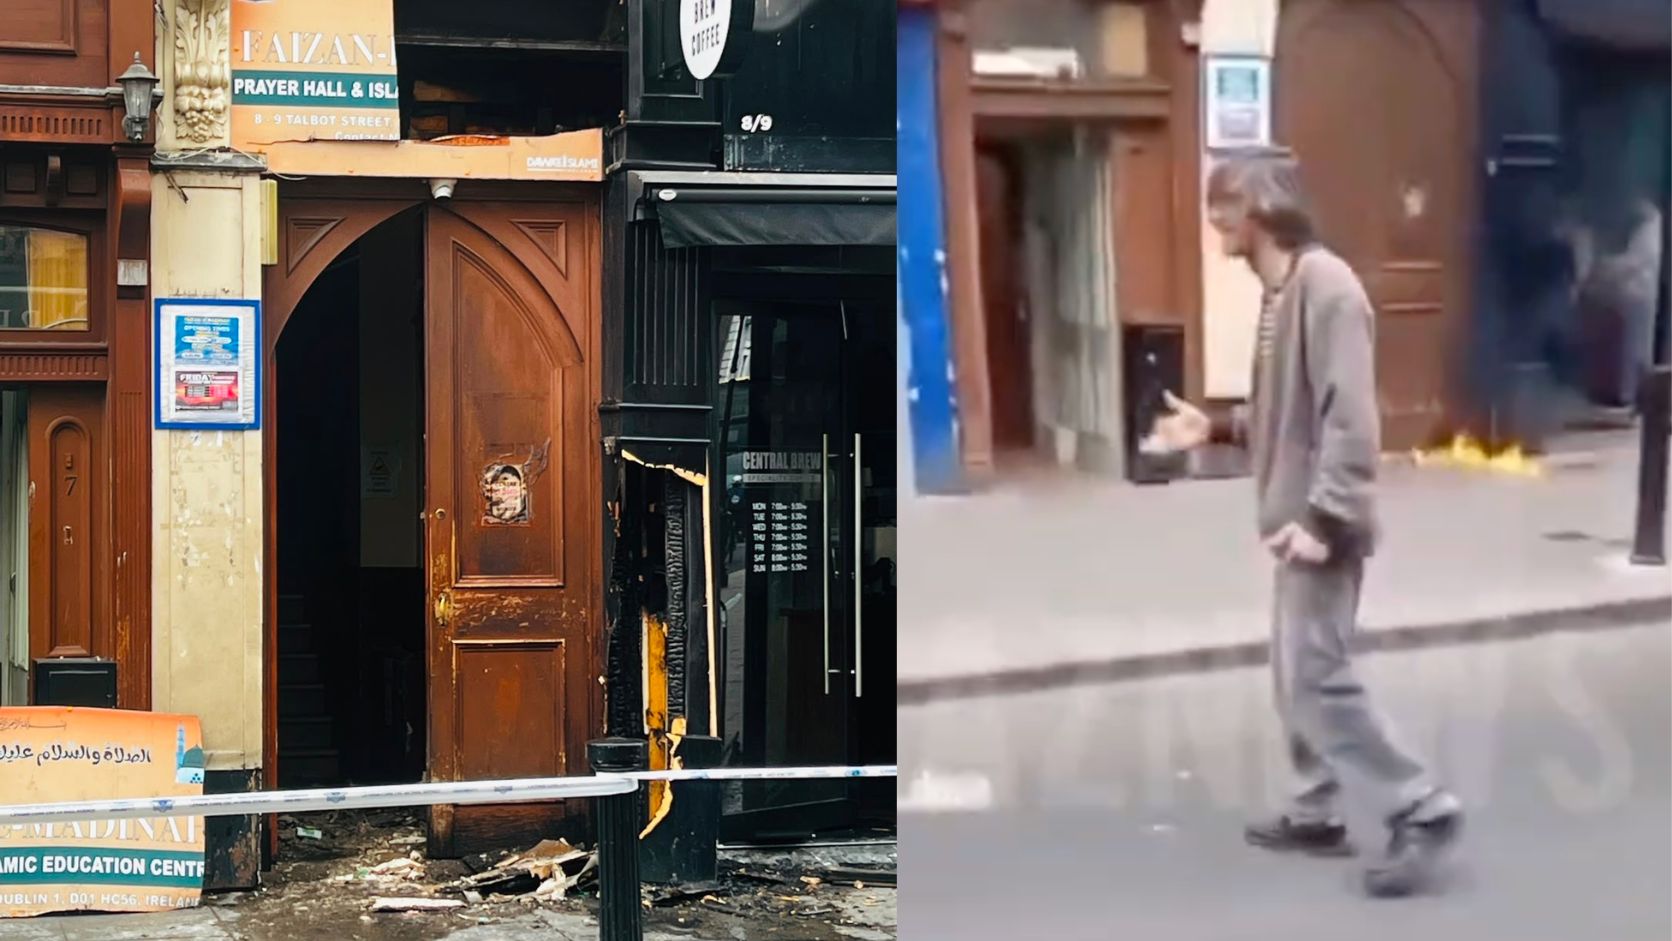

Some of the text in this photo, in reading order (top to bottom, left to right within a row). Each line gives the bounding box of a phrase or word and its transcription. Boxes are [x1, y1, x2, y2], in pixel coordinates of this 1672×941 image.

[692, 23, 719, 56] COFFEE
[234, 78, 299, 96] PRAYER
[303, 80, 347, 97] HALL
[351, 81, 363, 98] &
[274, 114, 281, 125] 9
[286, 114, 336, 126] TALBOT
[741, 114, 772, 133] 8/9
[181, 373, 212, 384] FRIDAY
[742, 452, 821, 470] CENTRAL BREW
[64, 475, 78, 496] 7
[42, 855, 145, 875] EDUCATION
[0, 893, 48, 905] UBLIN
